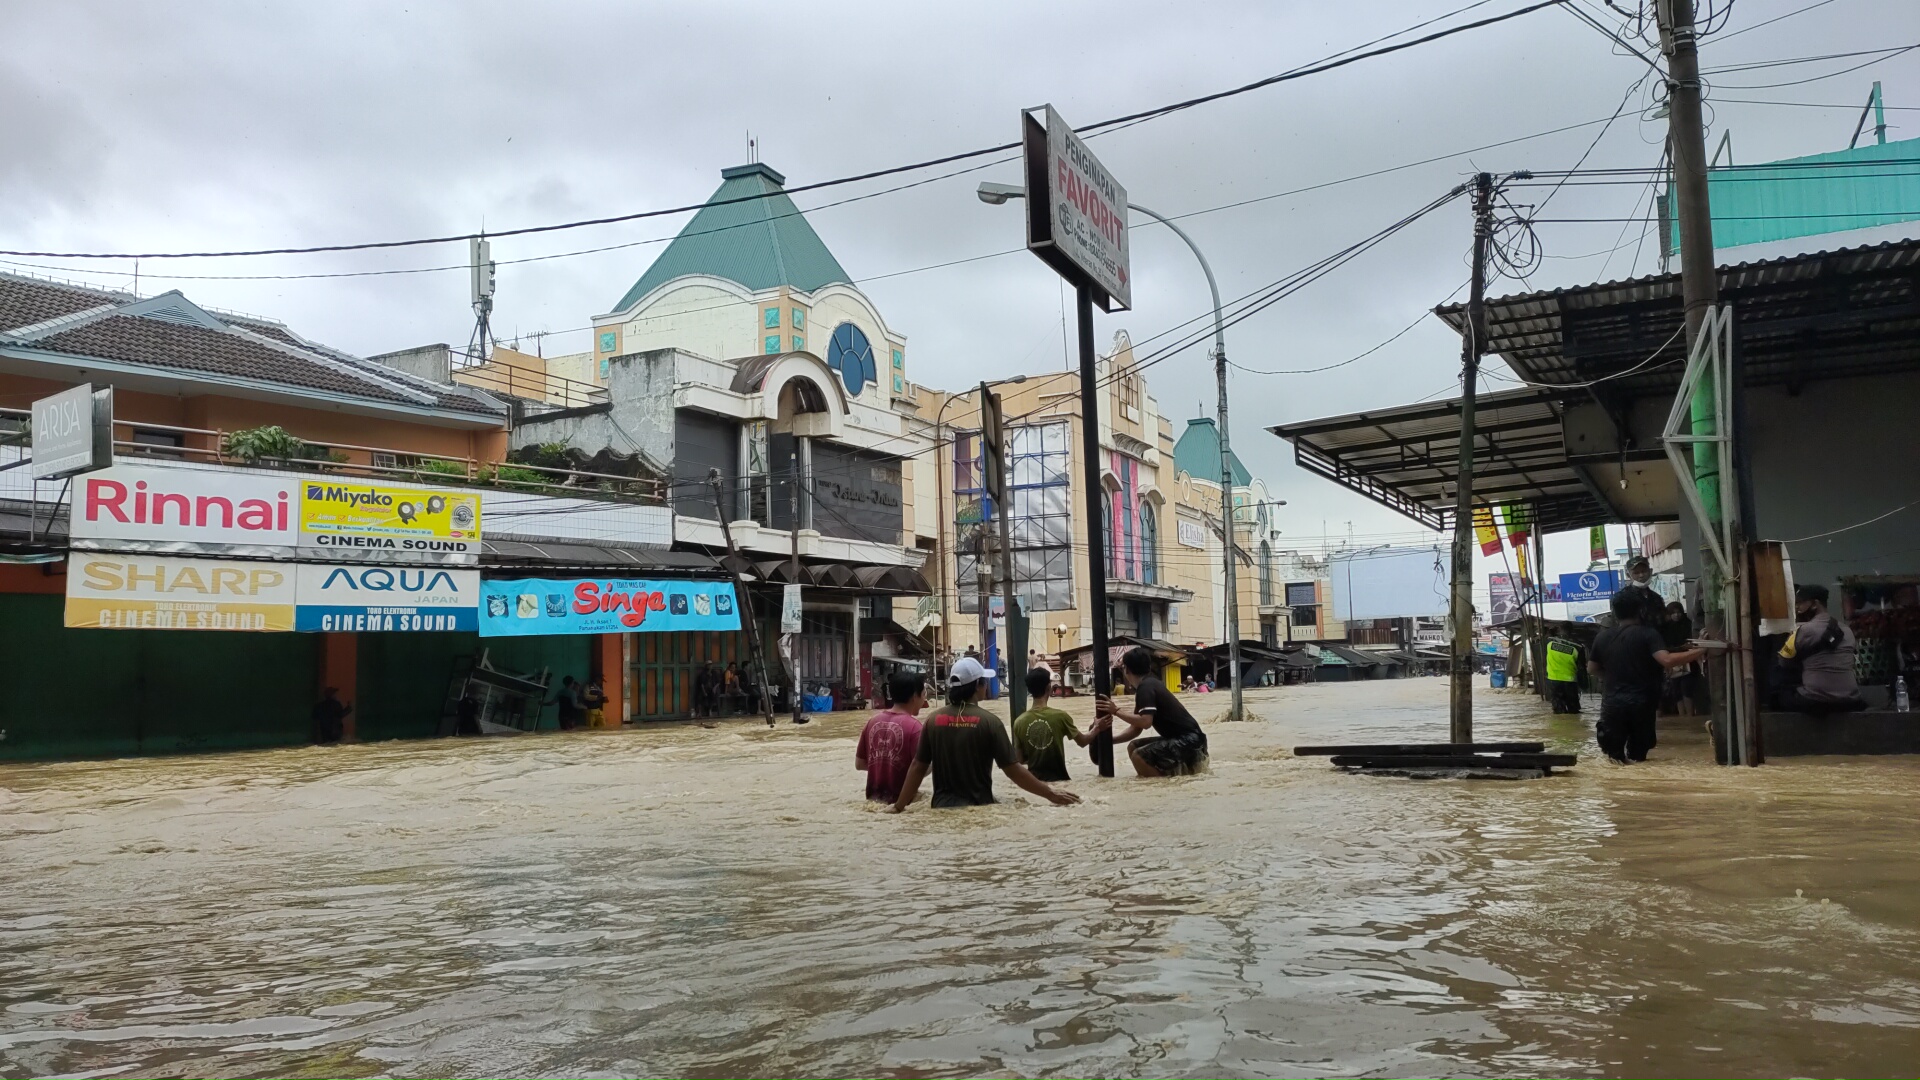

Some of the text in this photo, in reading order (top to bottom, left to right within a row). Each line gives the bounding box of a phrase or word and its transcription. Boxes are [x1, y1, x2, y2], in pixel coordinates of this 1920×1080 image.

[1064, 132, 1116, 206] PENGINAPAN
[1057, 153, 1124, 253] FAVORIT
[39, 398, 81, 442] ARISA
[85, 478, 289, 532] Rinnai
[326, 487, 393, 508] Miyako
[316, 535, 467, 552] CINEMA SOUND
[1185, 523, 1205, 543] Elisha
[82, 561, 284, 596] SHARP
[321, 568, 459, 592] AQUA
[155, 603, 217, 612] TOKO ELEKTRONIK
[414, 596, 459, 604] JAPAN
[572, 582, 667, 628] Singa
[100, 609, 265, 630] CINEMA SOUND
[367, 607, 417, 615] TOKO ELEKTRONIK
[322, 614, 456, 631] CINEMA SOUND
